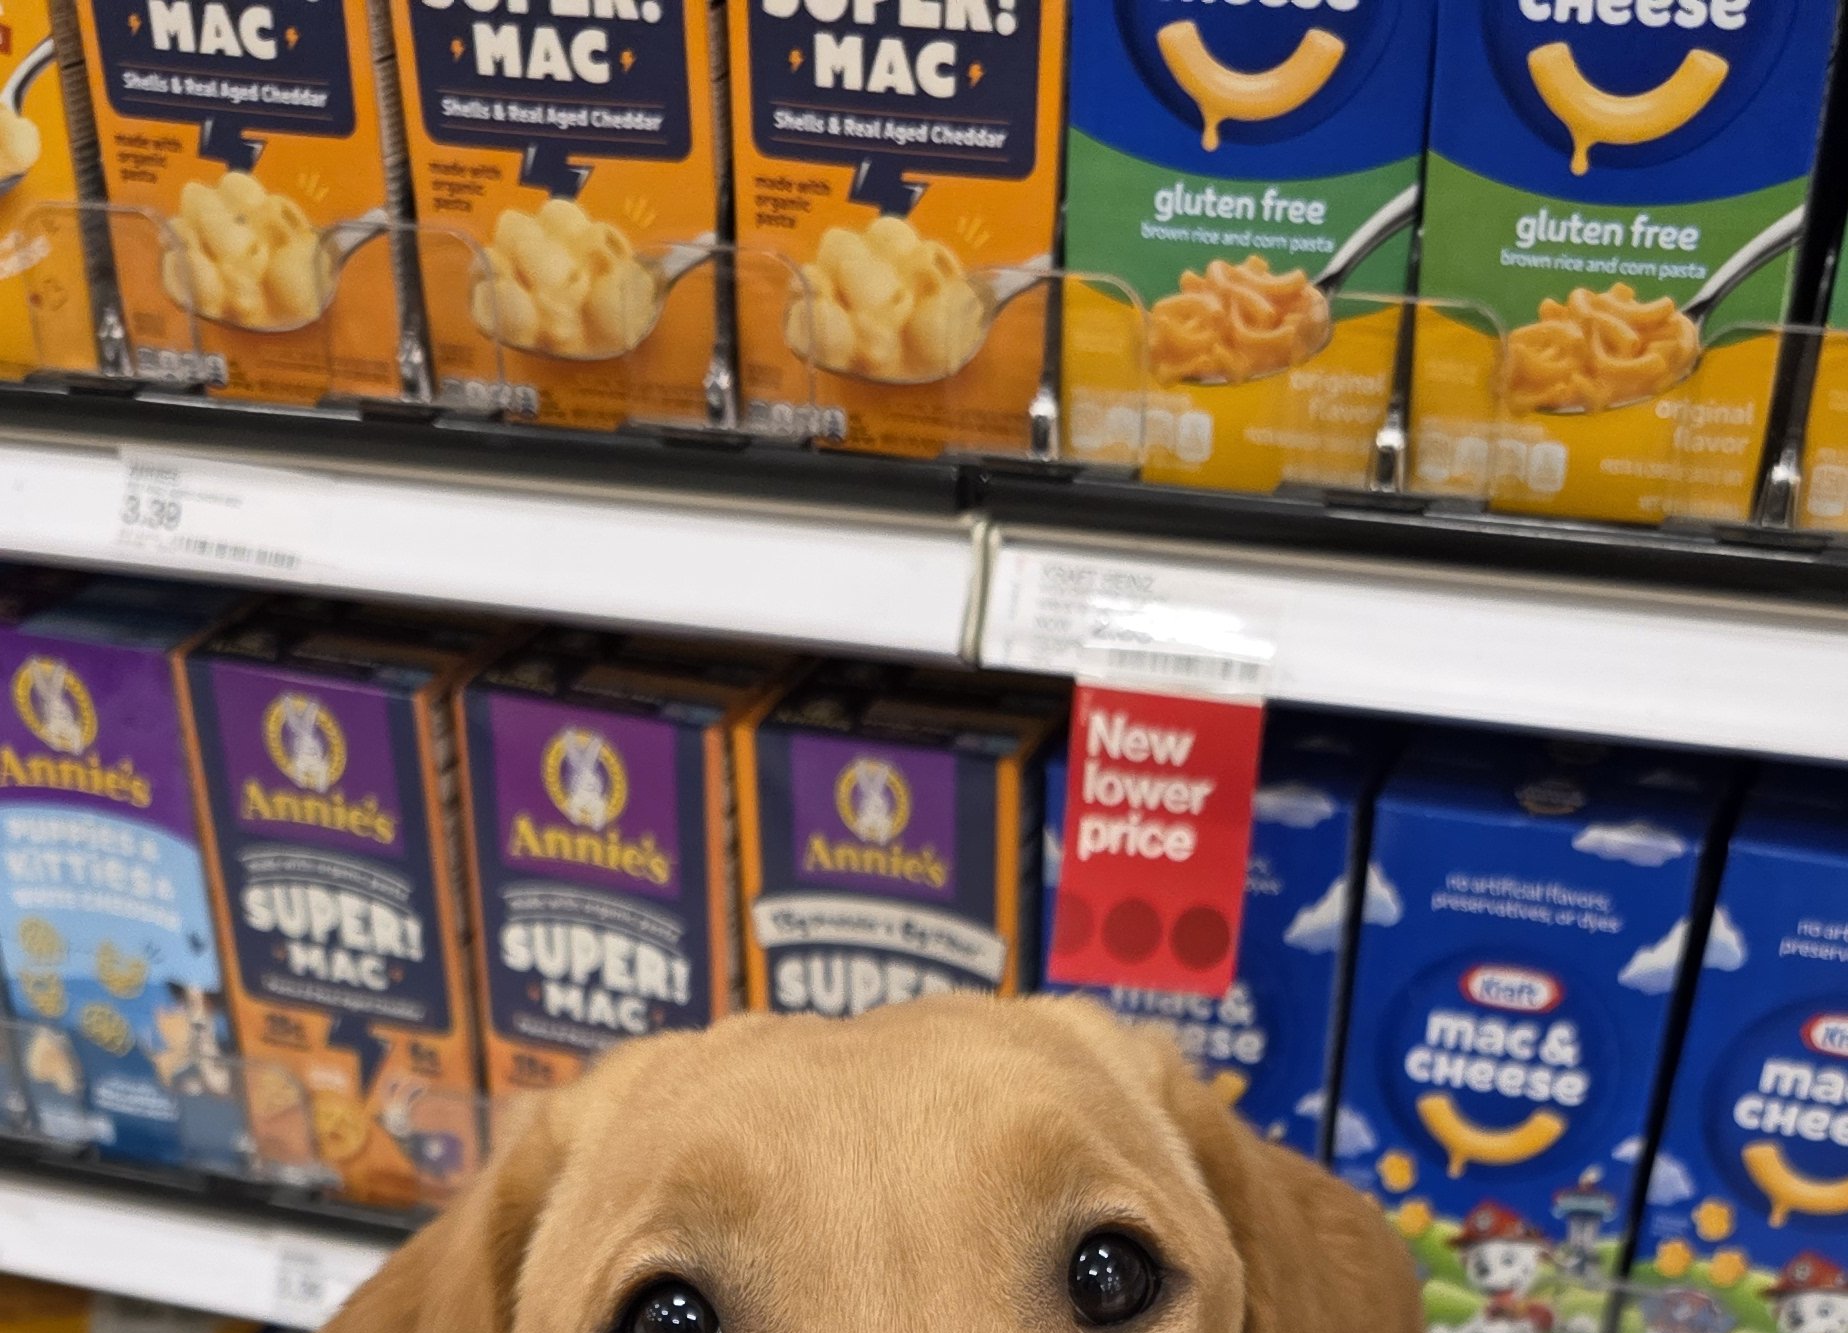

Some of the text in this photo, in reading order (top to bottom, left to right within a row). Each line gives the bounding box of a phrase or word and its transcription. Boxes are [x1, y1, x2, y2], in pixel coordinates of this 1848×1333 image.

[148, 0, 278, 60] MAC
[472, 21, 611, 84] MAC
[813, 31, 957, 98] MAC
[123, 71, 328, 108] Shells & Real Aged Cheddar
[441, 96, 663, 132] Shells & Real Aged Cheddar
[773, 108, 1007, 149] Shells & Real Aged Cheddar
[1154, 181, 1326, 225] gluten free
[1140, 221, 1334, 254] brown rice and corn pasta
[1515, 208, 1699, 251] gluten free
[1500, 248, 1706, 280] brown rice and corn pasta
[1655, 398, 1755, 427] original
[1673, 425, 1750, 454] flavor
[120, 495, 182, 531] 3.39
[1086, 711, 1196, 768] New
[0, 747, 152, 808] Annie's
[1082, 758, 1217, 815] lower
[241, 777, 395, 846] Annie's
[1077, 809, 1198, 862] price
[510, 813, 670, 885] Annie's
[804, 834, 947, 888] Annie's
[1446, 873, 1470, 892] no
[242, 882, 424, 962] SUPER!
[1555, 911, 1576, 926] or
[1577, 911, 1623, 934] dyes
[287, 942, 389, 991] MAC
[500, 922, 691, 1007] SUPER!
[543, 978, 648, 1035] MAC
[1218, 983, 1256, 1026] &
[1480, 977, 1537, 1006] Kraft
[1426, 1010, 1580, 1067] mac &
